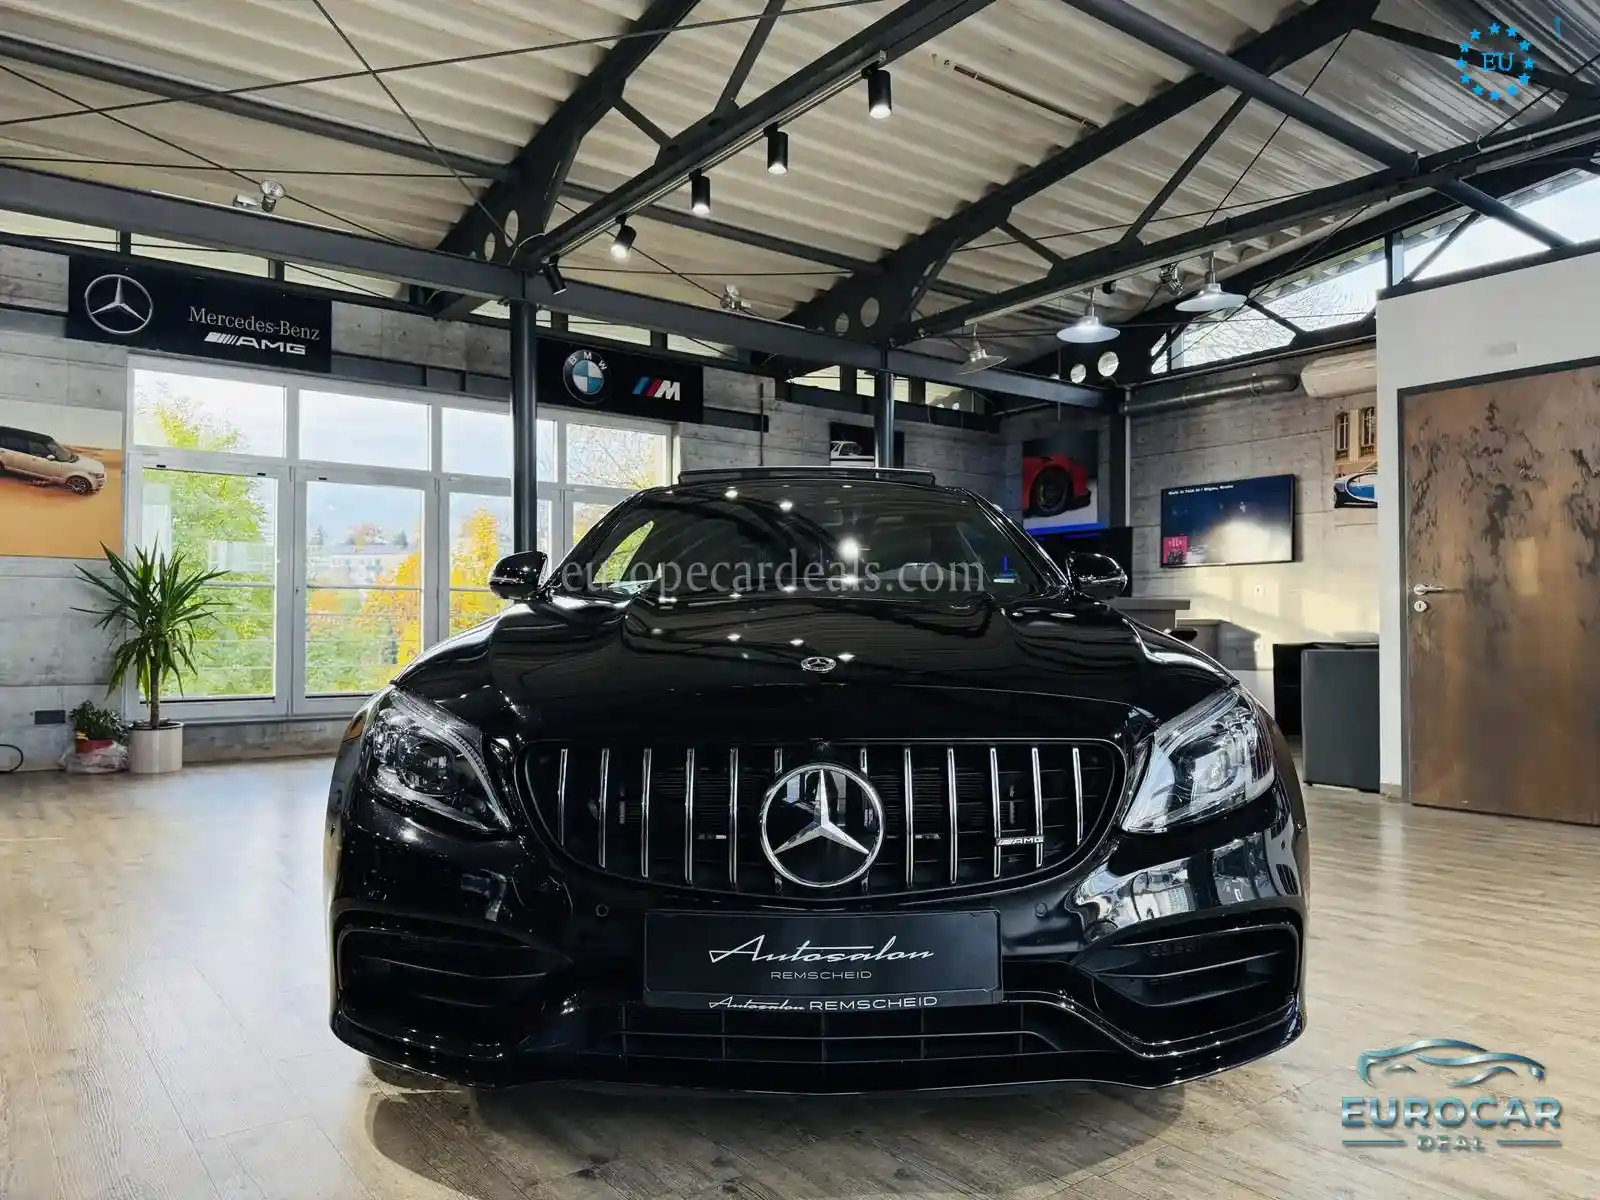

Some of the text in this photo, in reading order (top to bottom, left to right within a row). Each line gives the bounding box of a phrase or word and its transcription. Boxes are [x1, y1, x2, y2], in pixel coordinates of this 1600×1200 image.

[188, 305, 321, 341] Mercedes-Benz
[235, 336, 306, 356] AMG
[708, 934, 935, 963] Autosalon
[770, 970, 873, 981] REMSCHEID
[708, 995, 938, 1012] Autosalon REMSCHEID
